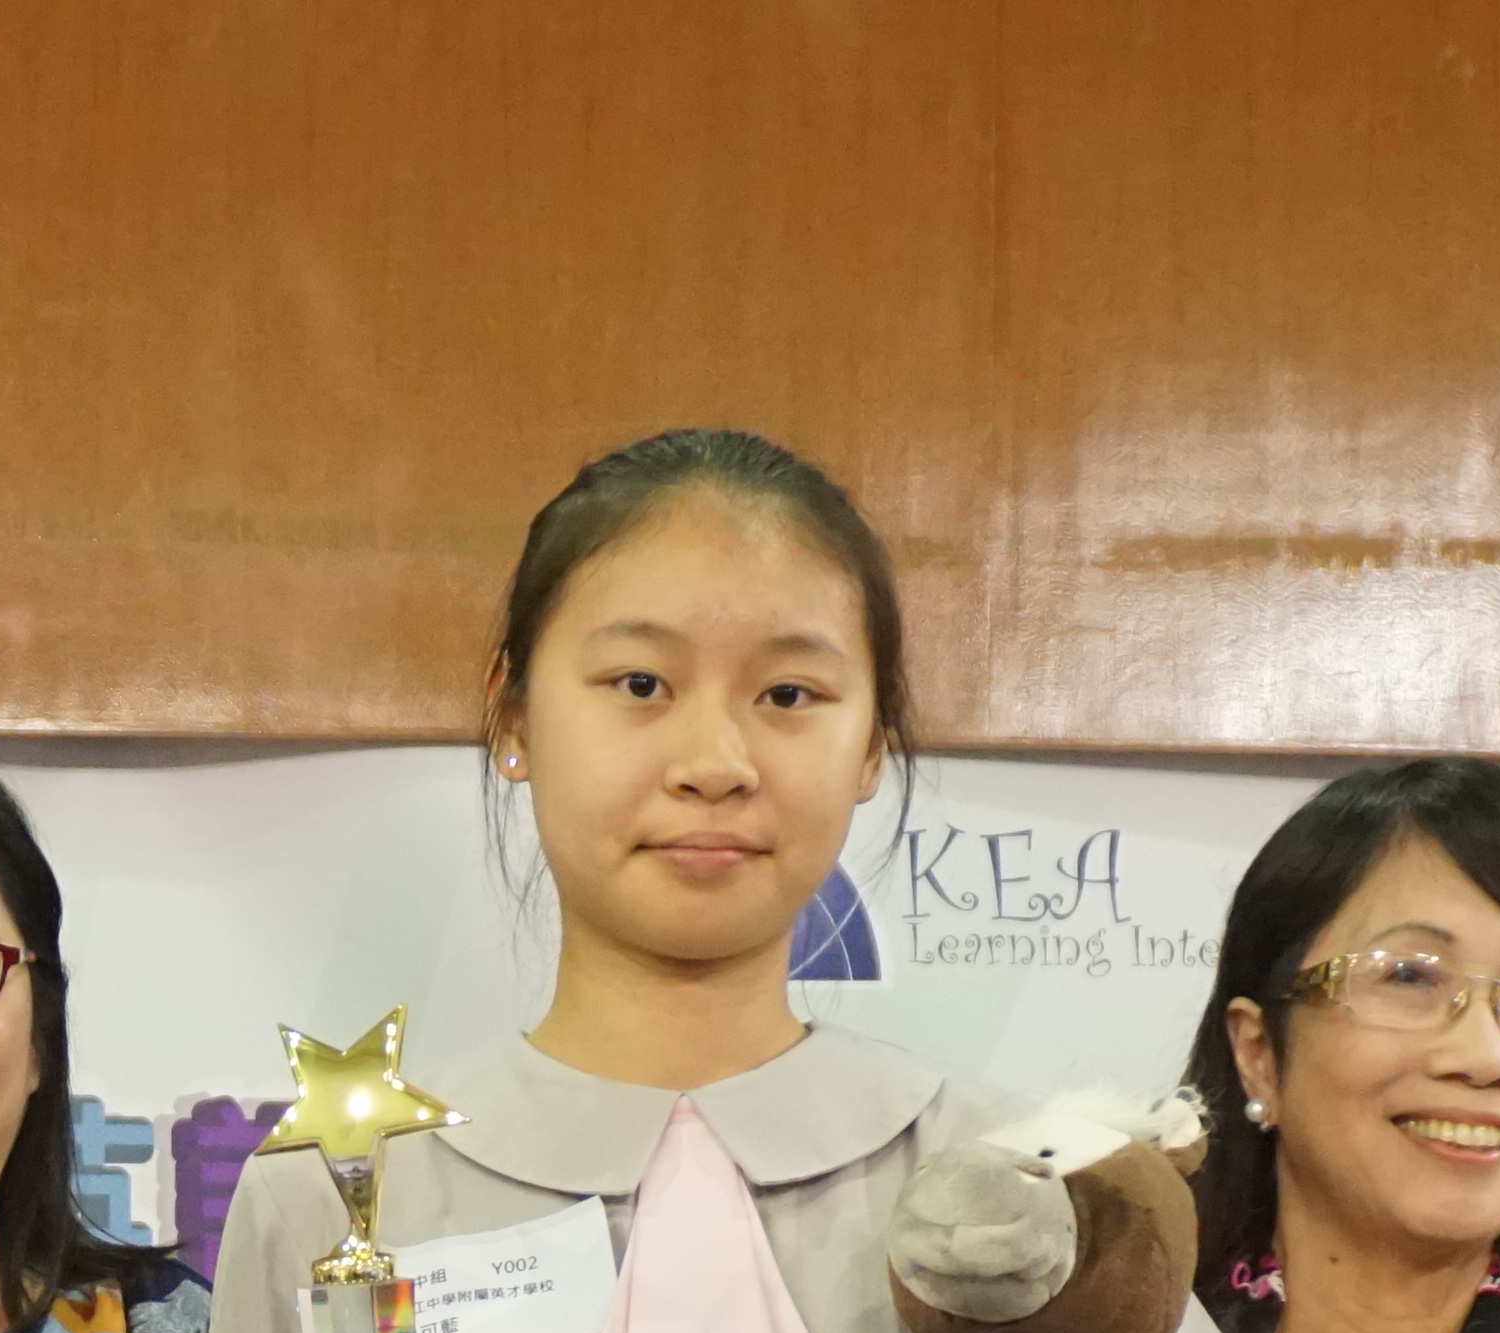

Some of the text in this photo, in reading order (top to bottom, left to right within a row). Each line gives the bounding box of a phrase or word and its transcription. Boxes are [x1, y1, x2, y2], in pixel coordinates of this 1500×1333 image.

[904, 824, 1131, 923] KEA
[909, 922, 1222, 977] Learning Inte
[414, 1256, 539, 1289] 中組 Y002
